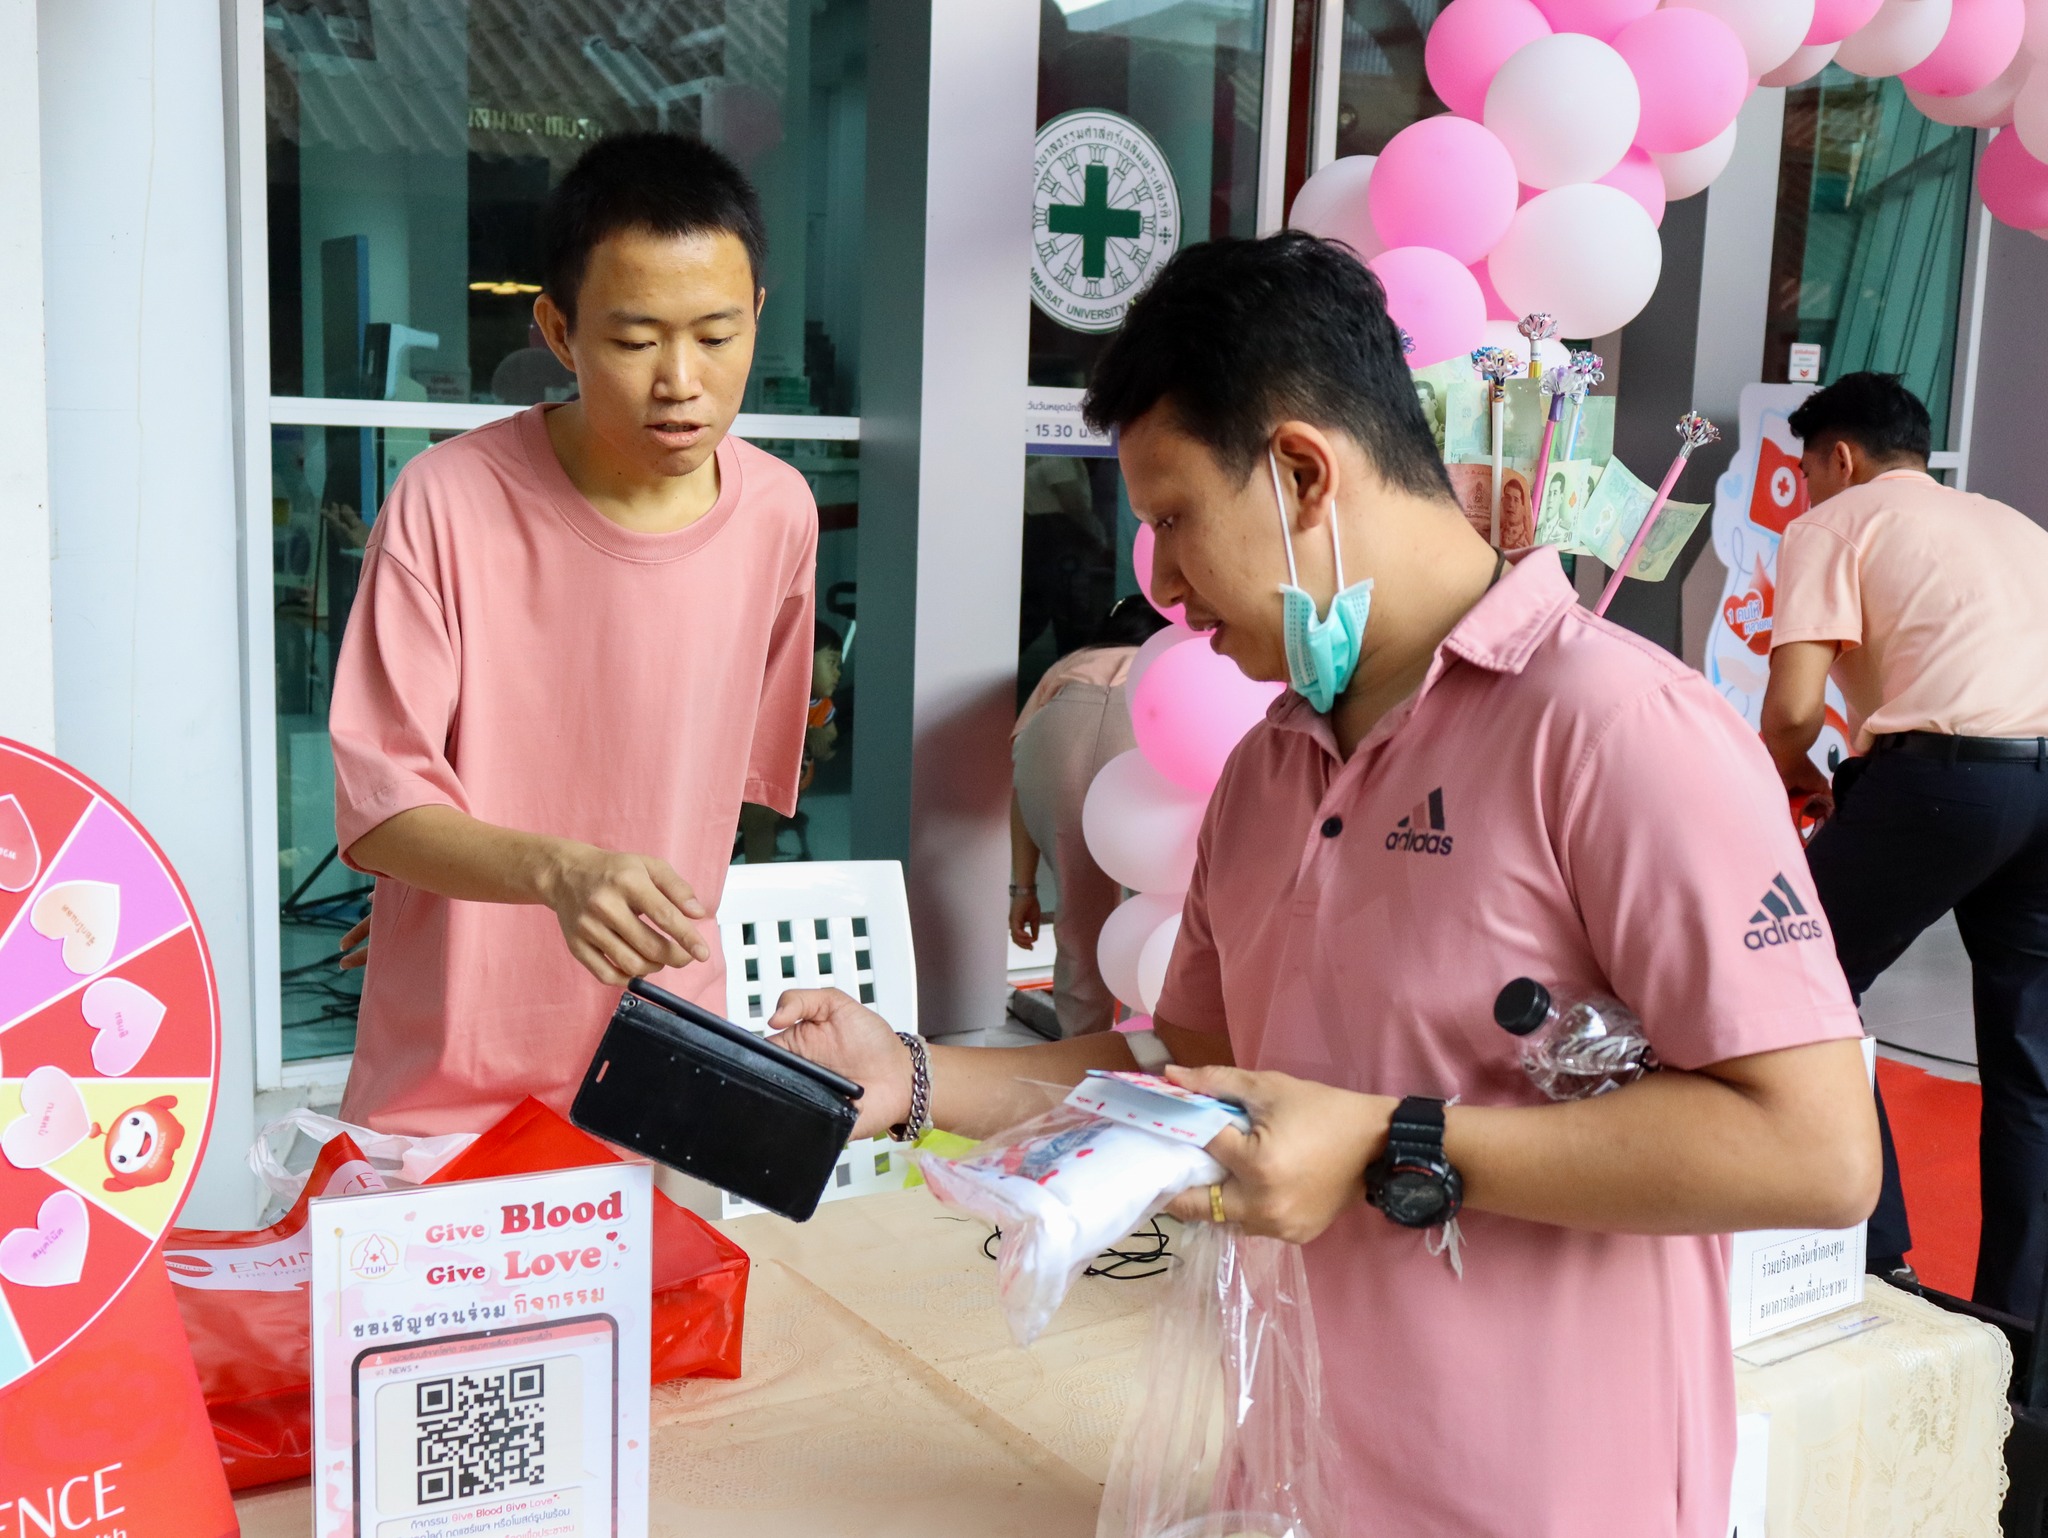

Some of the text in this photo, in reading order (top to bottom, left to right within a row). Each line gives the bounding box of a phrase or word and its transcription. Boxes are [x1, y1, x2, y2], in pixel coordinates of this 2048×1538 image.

[1066, 302, 1126, 320] UNIVERSITY
[1035, 424, 1073, 438] 15.30
[1385, 827, 1453, 857] adidas
[1743, 919, 1823, 951] adidas
[425, 1190, 624, 1245] Give Blood
[364, 1265, 387, 1276] TUH
[426, 1246, 602, 1287] Give Love
[1760, 1273, 1848, 1319] ธนาคารเลือดเพื่อประชาชน
[353, 1302, 507, 1338] ขอเชิญชวนร่วม
[513, 1286, 605, 1314] กิจกรรม
[388, 1364, 413, 1376] NEWS
[452, 1512, 473, 1523] Give
[476, 1505, 503, 1519] Blood
[505, 1502, 527, 1513] Give
[529, 1497, 553, 1508] Love
